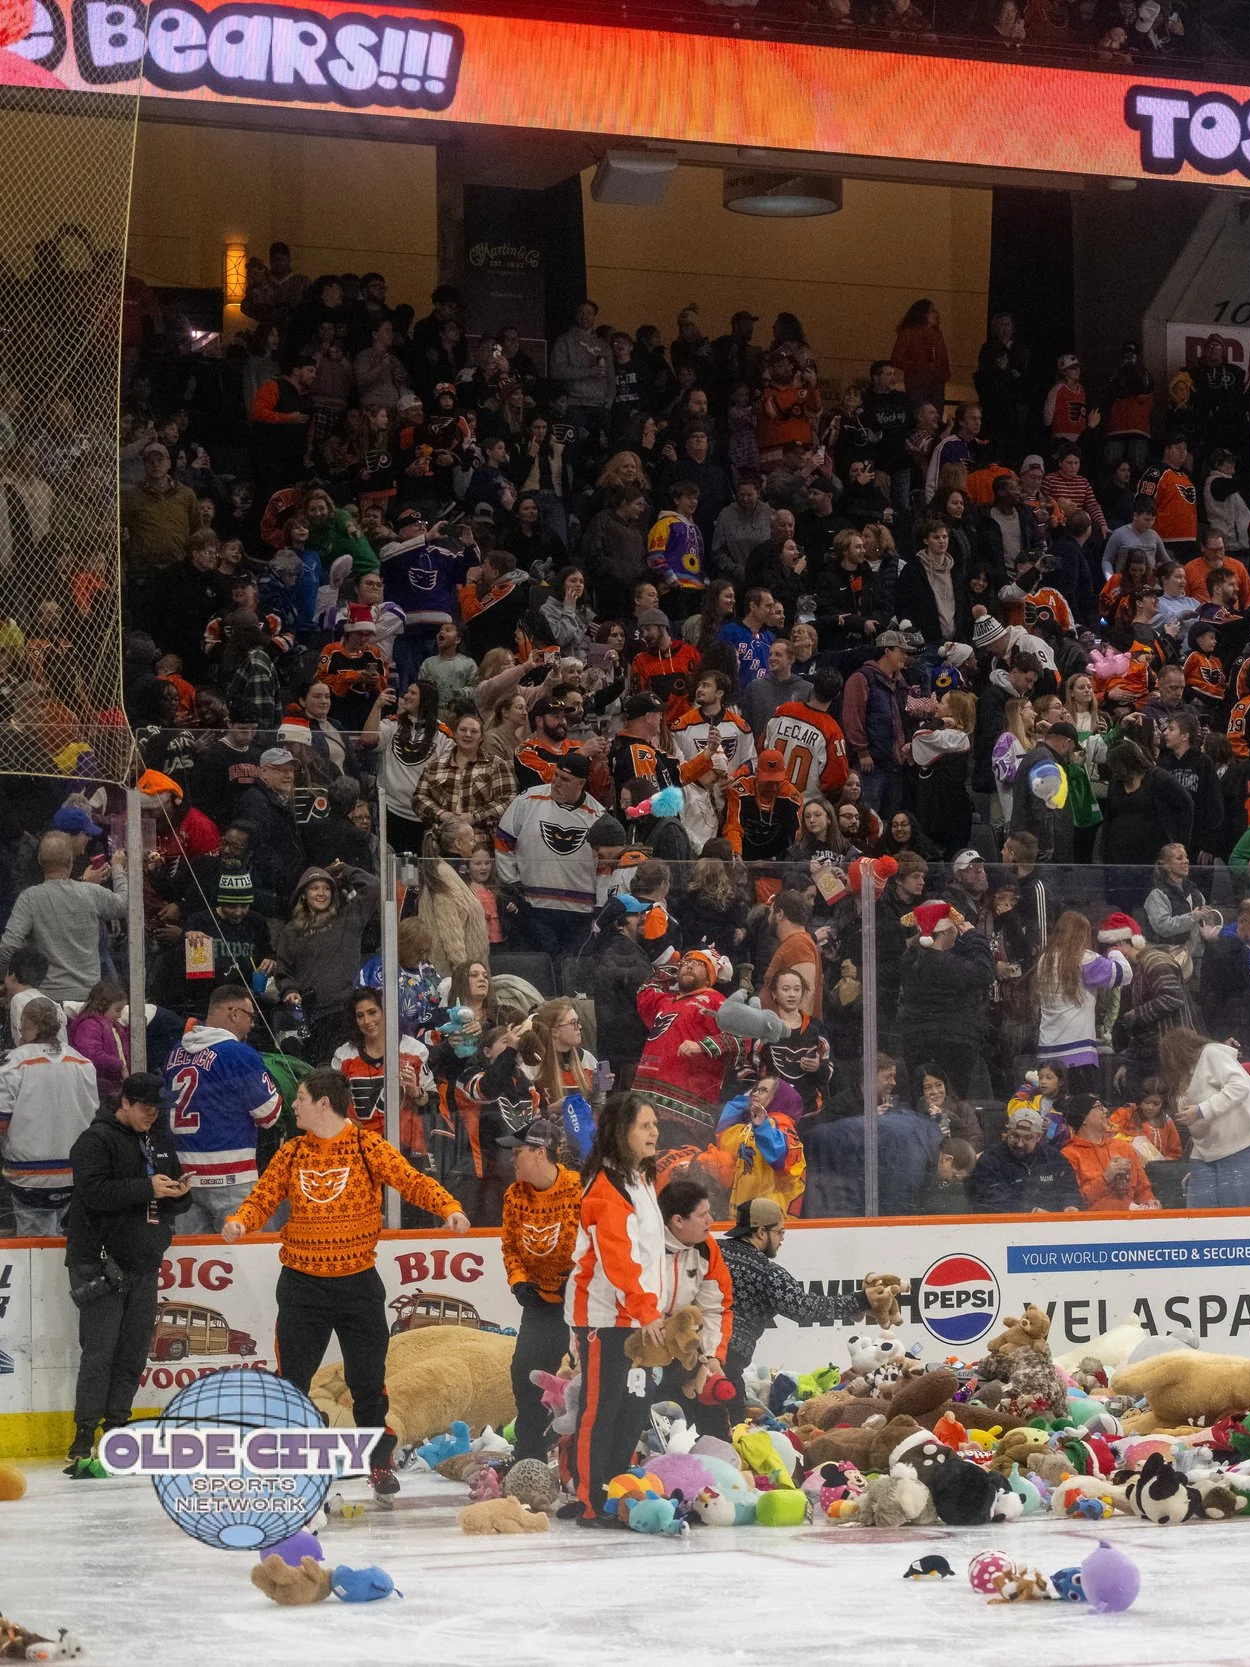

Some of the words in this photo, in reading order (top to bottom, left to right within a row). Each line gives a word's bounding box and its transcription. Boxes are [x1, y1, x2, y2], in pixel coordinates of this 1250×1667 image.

[739, 643, 766, 679] RANG
[1229, 718, 1243, 732] 19
[170, 1066, 200, 1134] 2
[157, 1257, 233, 1291] BIG
[395, 1249, 484, 1285] BIG
[1022, 1252, 1058, 1266] YOUR
[1061, 1251, 1108, 1265] WORLD
[1111, 1248, 1188, 1263] CONNECTED
[1191, 1248, 1201, 1260] &
[924, 1289, 994, 1309] PEPSI
